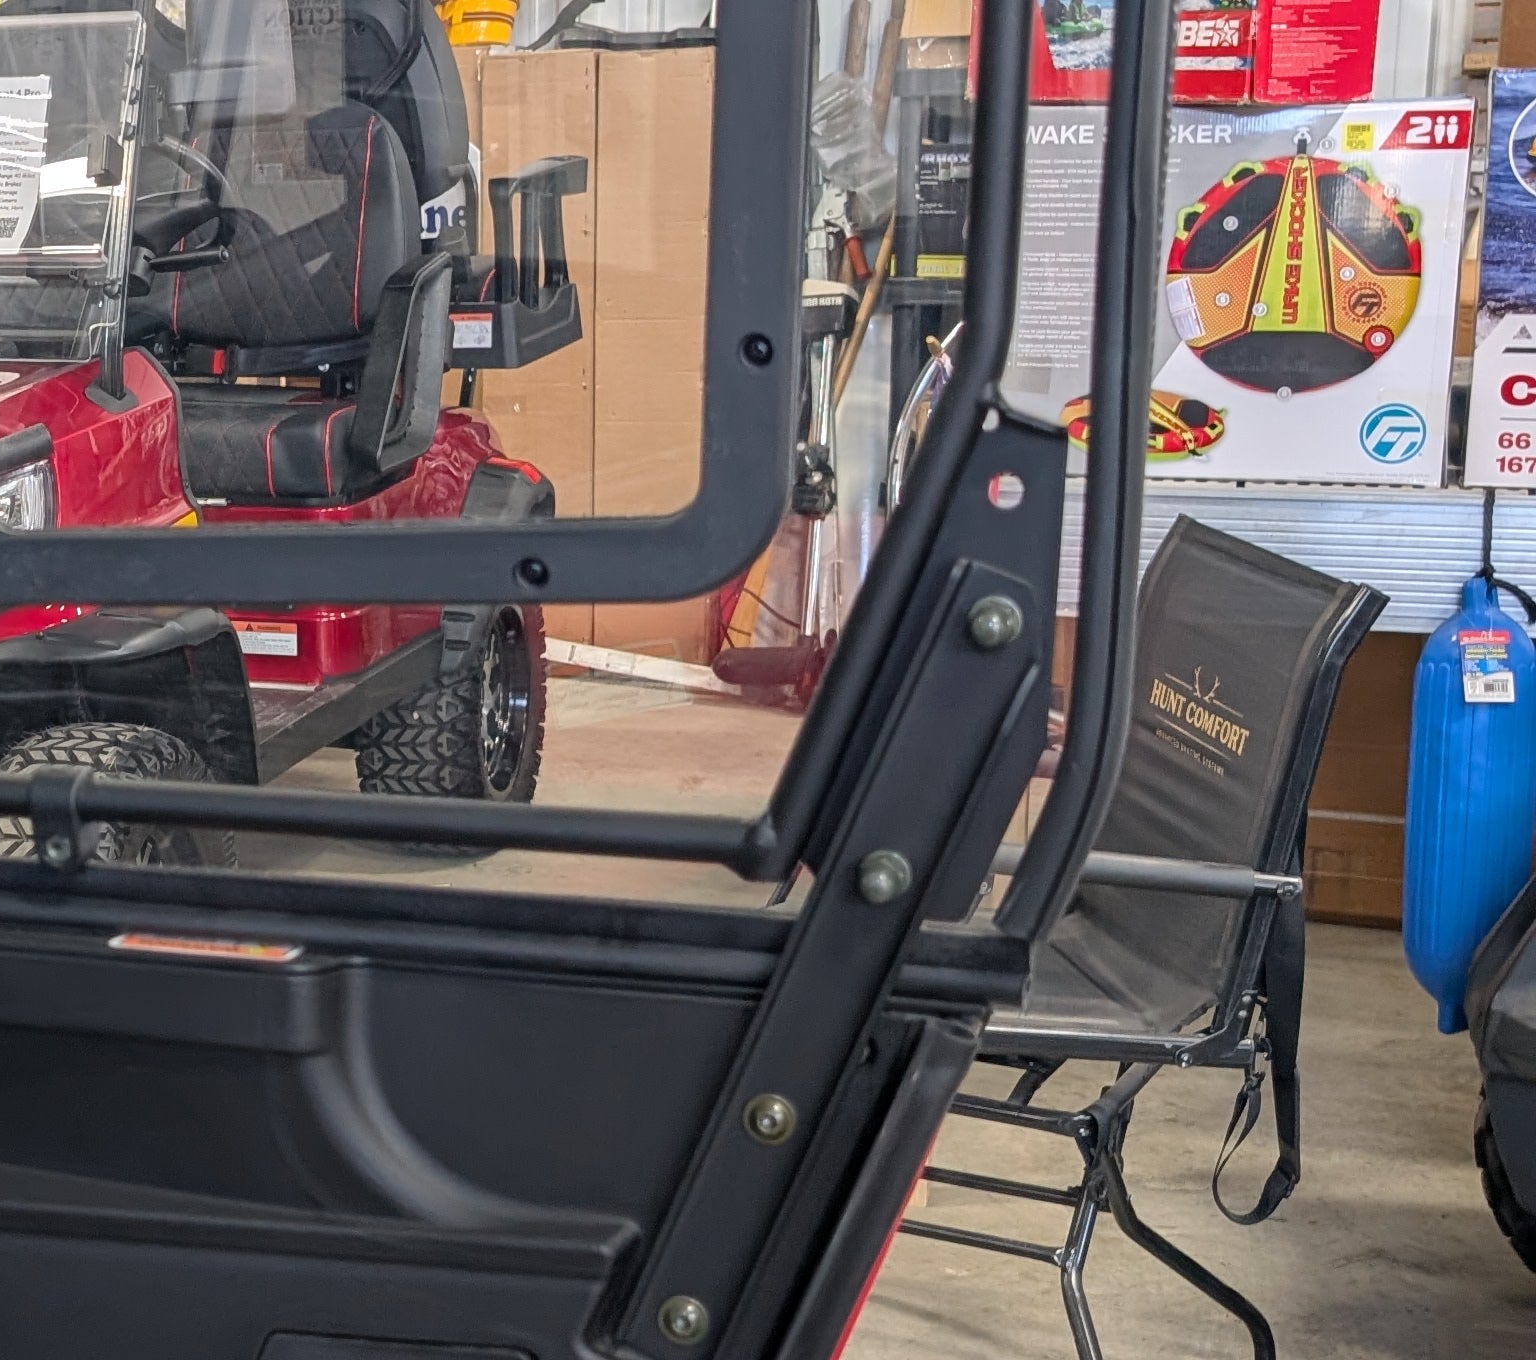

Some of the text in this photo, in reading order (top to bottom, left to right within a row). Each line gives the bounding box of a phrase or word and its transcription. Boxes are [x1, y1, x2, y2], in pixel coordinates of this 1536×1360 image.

[1026, 124, 1094, 145] WAKE
[1406, 116, 1432, 144] 2
[1281, 167, 1309, 324] WAKE SHOCKER
[1498, 432, 1531, 450] 66
[1496, 456, 1536, 474] 167
[1150, 678, 1186, 718] HUNT
[1185, 701, 1250, 756] COMFORT
